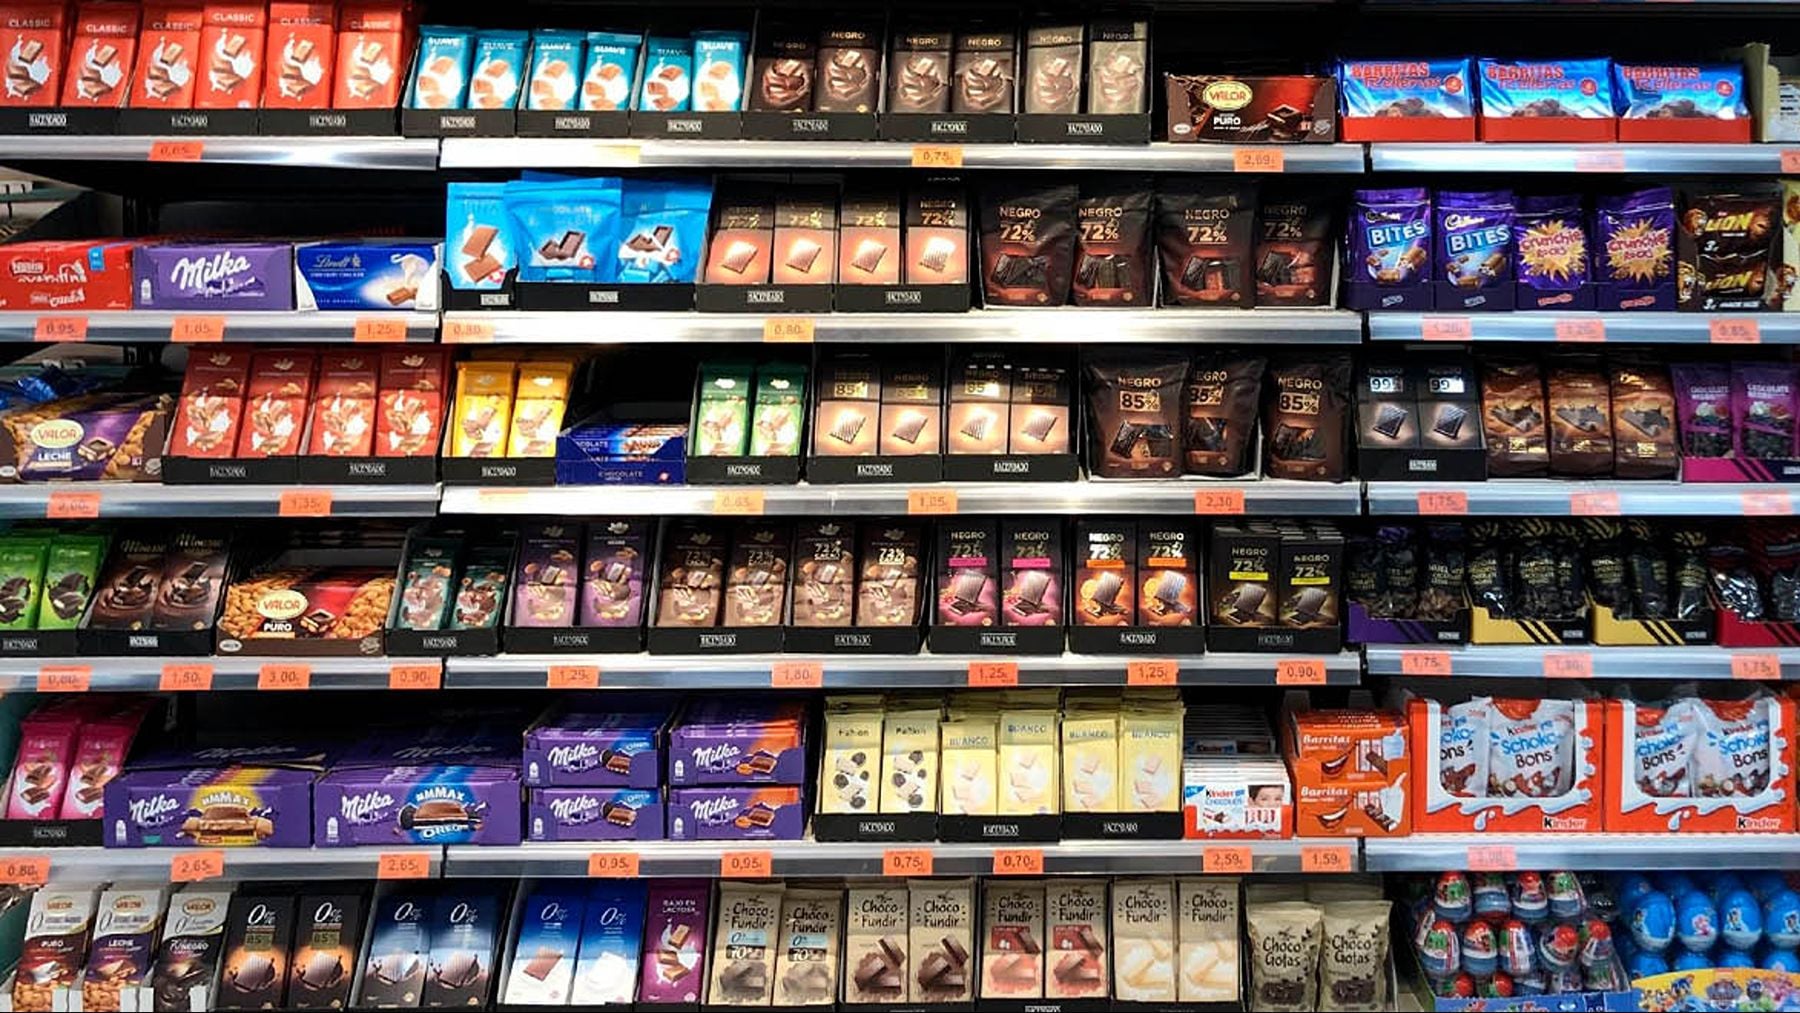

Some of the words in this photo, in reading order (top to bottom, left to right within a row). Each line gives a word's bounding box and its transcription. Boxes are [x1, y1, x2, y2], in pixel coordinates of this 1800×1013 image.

[212, 13, 254, 24] CLASSIC
[86, 24, 127, 34] CLASSIC
[968, 38, 1001, 48] NEGRO
[1209, 90, 1246, 102] VALOR
[1213, 117, 1241, 126] PURO
[1000, 206, 1041, 219] NEGRO
[1078, 206, 1123, 218] NEGRO
[1185, 208, 1230, 220] NEGRO
[1000, 223, 1036, 242] 72%
[1080, 223, 1119, 240] 72%
[1187, 225, 1228, 242] 72%
[1371, 221, 1425, 246] BITES
[1451, 229, 1510, 251] BITES
[171, 251, 251, 290] Milka
[1119, 377, 1161, 388] NEGRO
[1278, 377, 1322, 390] NEGRO
[1121, 392, 1160, 410] 85%
[1280, 394, 1320, 413] 85%
[38, 428, 77, 440] VALOR
[951, 531, 986, 540] NEGRO
[1014, 532, 1049, 541] NEGRO
[1089, 533, 1124, 542] NEGRO
[1150, 533, 1184, 541] NEGRO
[1232, 547, 1268, 556] NEGRO
[1294, 555, 1330, 563] NEGRO
[264, 602, 300, 611] VALOR
[264, 623, 292, 632] PURO
[1303, 734, 1350, 745] Barritas
[548, 743, 599, 768] Milka
[693, 743, 743, 766] Milka
[1515, 751, 1553, 768] Bons
[1642, 749, 1676, 770] Bons
[1732, 748, 1768, 768] Bons
[1301, 786, 1348, 797] Barritas
[129, 795, 180, 822] Milka
[342, 791, 394, 819] Milka
[550, 795, 599, 820] Milka
[690, 795, 740, 820] Milka
[684, 899, 696, 907] EN
[861, 900, 898, 914] Choco
[923, 900, 960, 914] Choco
[999, 897, 1034, 910] Choco
[1059, 894, 1095, 908] Choco
[1125, 895, 1162, 909] Choco
[1192, 895, 1227, 909] Choco
[732, 903, 769, 917] Choco
[793, 907, 829, 921] Choco
[1058, 909, 1094, 922] Fundir
[1126, 910, 1160, 923] Fundir
[1192, 910, 1226, 923] Fundir
[731, 914, 767, 930] Fundir
[861, 915, 897, 928] Fundir
[923, 915, 959, 928] Fundir
[998, 911, 1033, 924] Fundir
[791, 919, 828, 933] Fundir
[1262, 937, 1301, 953] Choco
[1331, 937, 1372, 951] Choco
[1264, 952, 1301, 968] Gotas
[1334, 950, 1371, 965] Gotas
